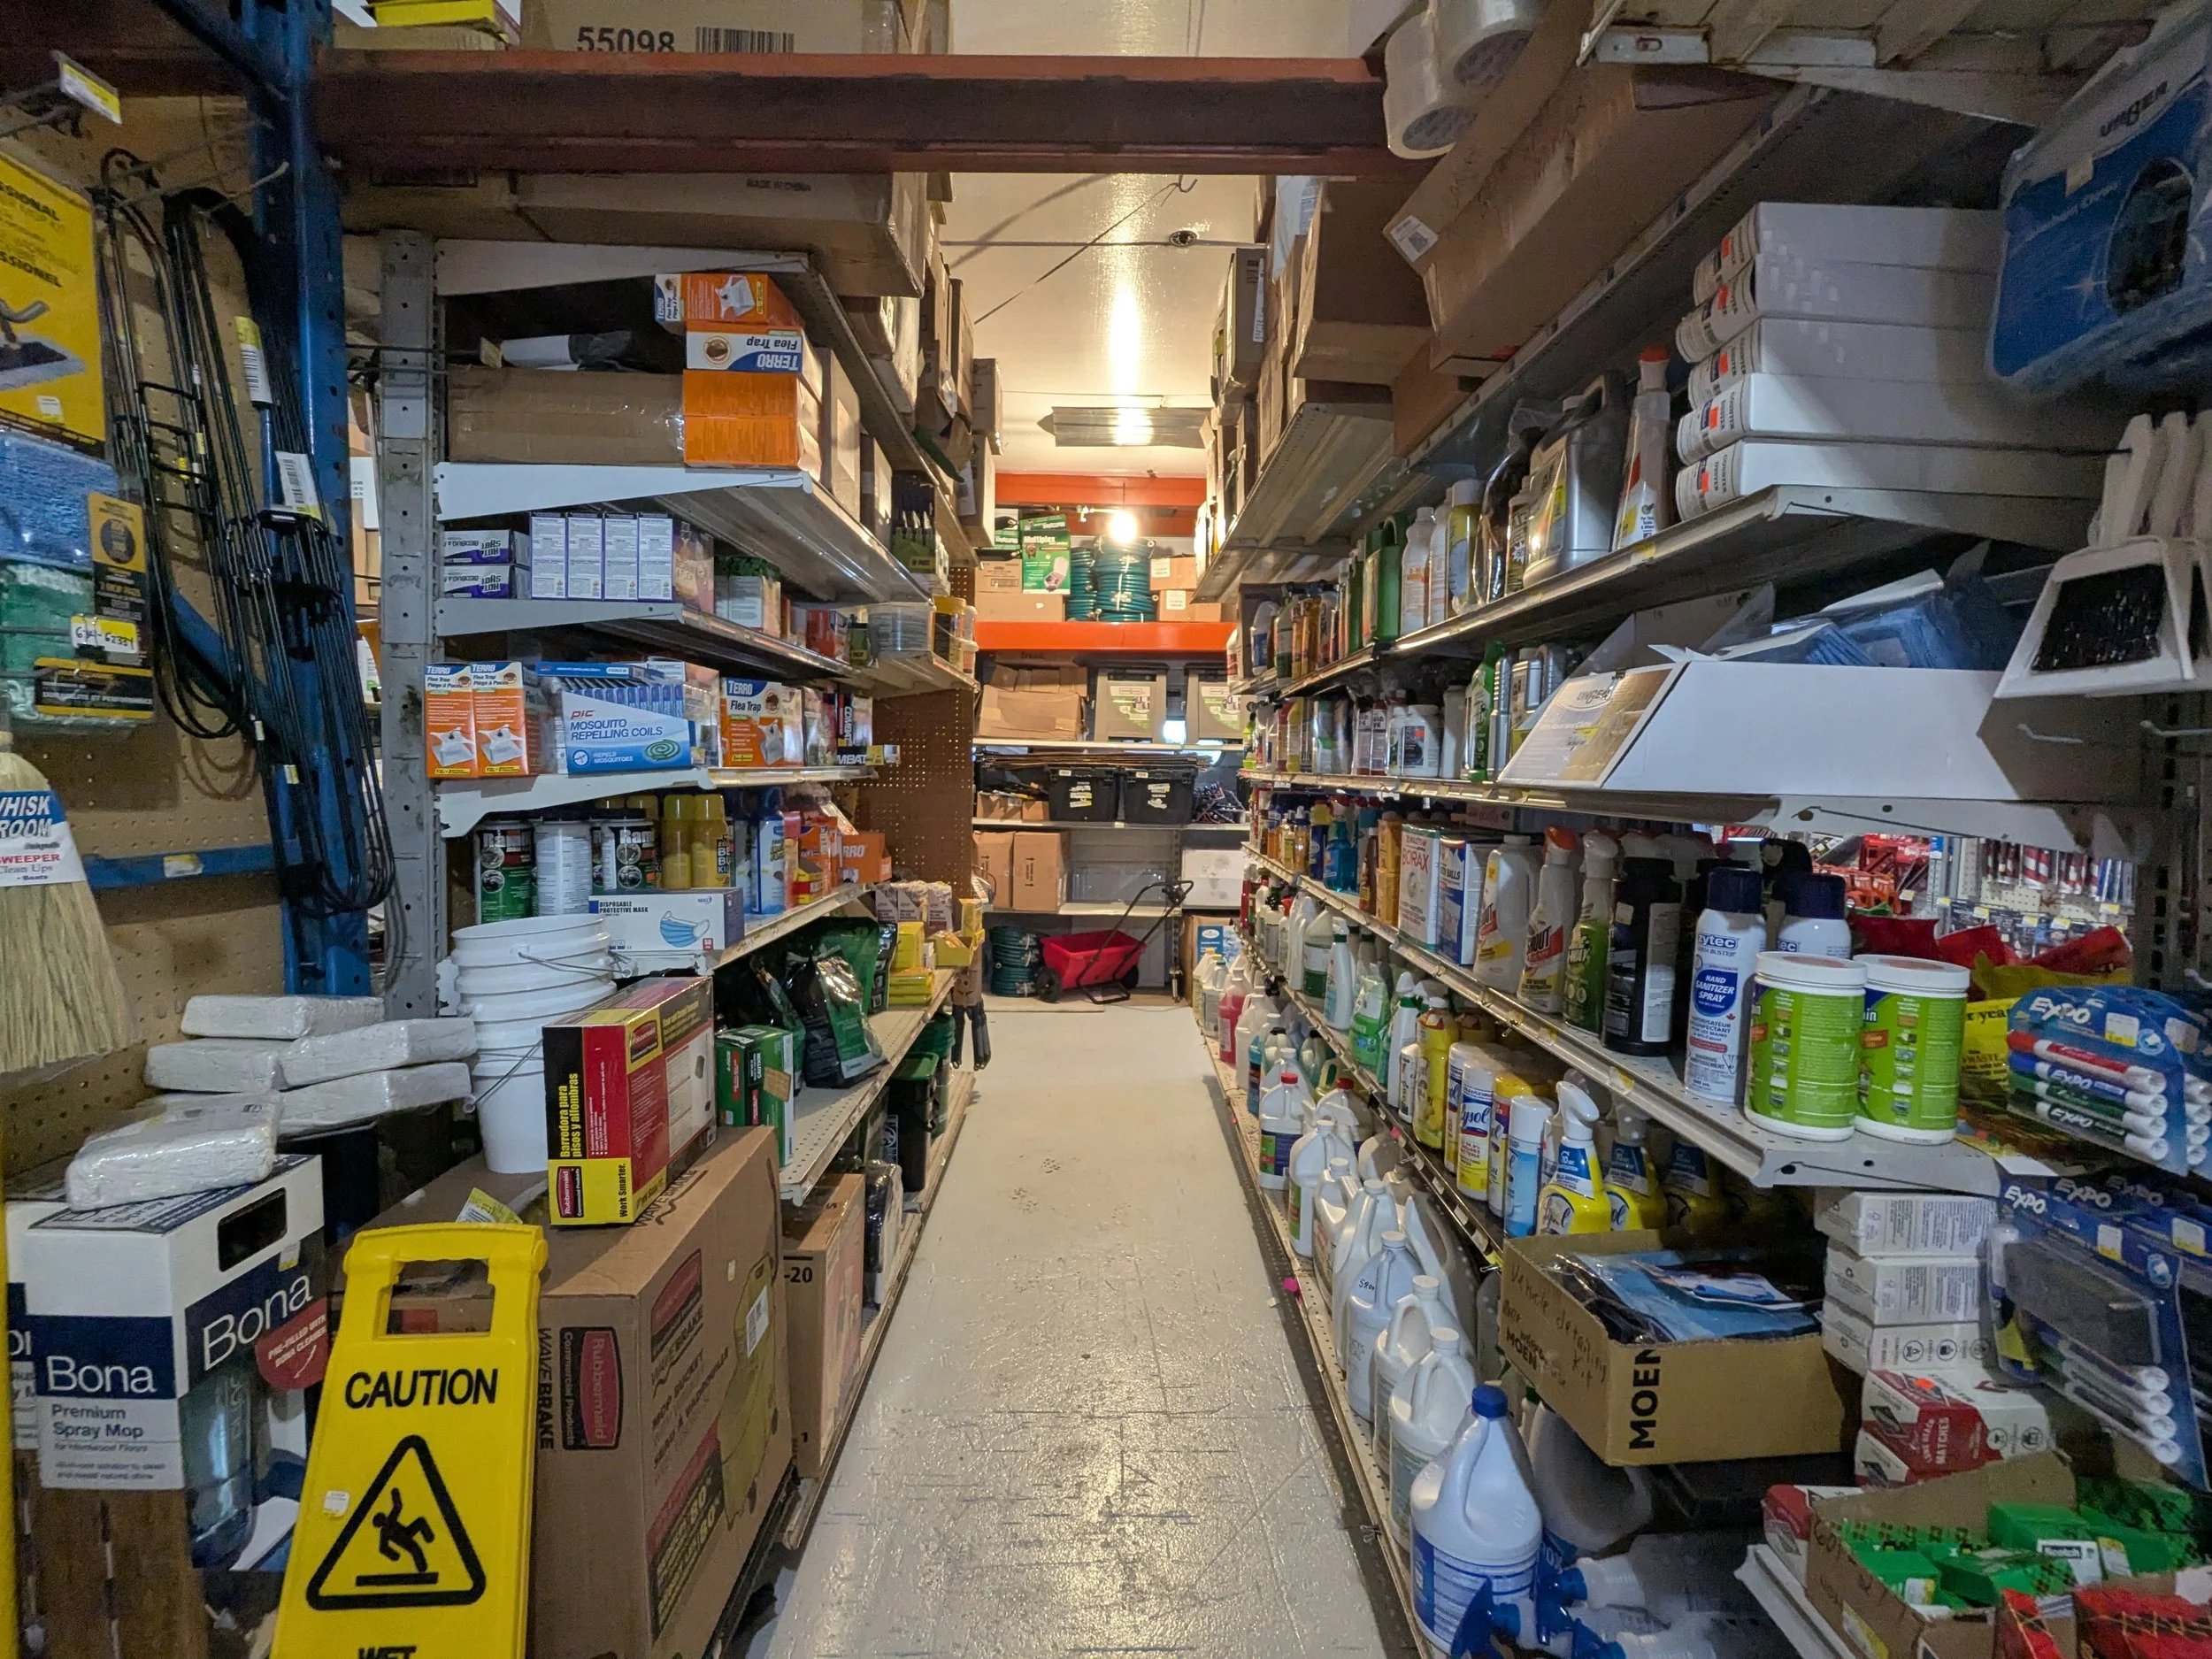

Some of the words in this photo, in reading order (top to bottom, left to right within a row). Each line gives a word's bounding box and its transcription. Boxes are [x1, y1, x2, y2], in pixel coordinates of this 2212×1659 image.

[577, 27, 675, 52] 55098
[746, 336, 770, 349] Trap
[774, 339, 797, 350] Flea
[757, 353, 799, 370] TERRO
[426, 666, 450, 675] TERRO
[472, 664, 495, 672] TERRO
[728, 680, 753, 695] TERRO
[730, 700, 746, 710] Flea
[747, 700, 762, 713] Trap
[571, 718, 627, 731] MOSQUITO
[572, 729, 629, 741] REPELLING
[631, 726, 663, 737] COILS
[836, 754, 866, 765] MBAT
[0, 818, 52, 839] ROOM
[1402, 848, 1430, 874] BORAX
[1447, 868, 1460, 880] BALLS
[1698, 934, 1737, 949] zytec
[1695, 979, 1735, 995] SANITIZER
[1699, 991, 1725, 1002] SPRAY
[2030, 996, 2092, 1025] EXPO
[2051, 1068, 2093, 1090] EXPO
[558, 1086, 569, 1107] para
[568, 1072, 580, 1122] alfombras
[2051, 1105, 2094, 1128] EXPO
[560, 1108, 571, 1158] Barredora
[571, 1131, 582, 1157] pisos
[618, 1163, 626, 1194] Smarter.
[2004, 1185, 2047, 1214] EXPO
[2055, 1177, 2112, 1209] EXPO
[618, 1194, 628, 1218] Work
[203, 1275, 314, 1372] Bona
[564, 1331, 573, 1396] Commercial
[46, 1356, 158, 1394] Bona
[344, 1368, 499, 1409] CAUTION
[538, 1327, 554, 1450] WAVEBRAKE
[591, 1337, 607, 1440] Rubbermaid
[51, 1403, 127, 1420] Premium
[52, 1421, 101, 1440] Spray
[105, 1424, 144, 1440] Mop
[564, 1399, 573, 1447] Products
[1935, 1417, 1950, 1465] MATCHES
[2045, 1545, 2080, 1559] Scotch
